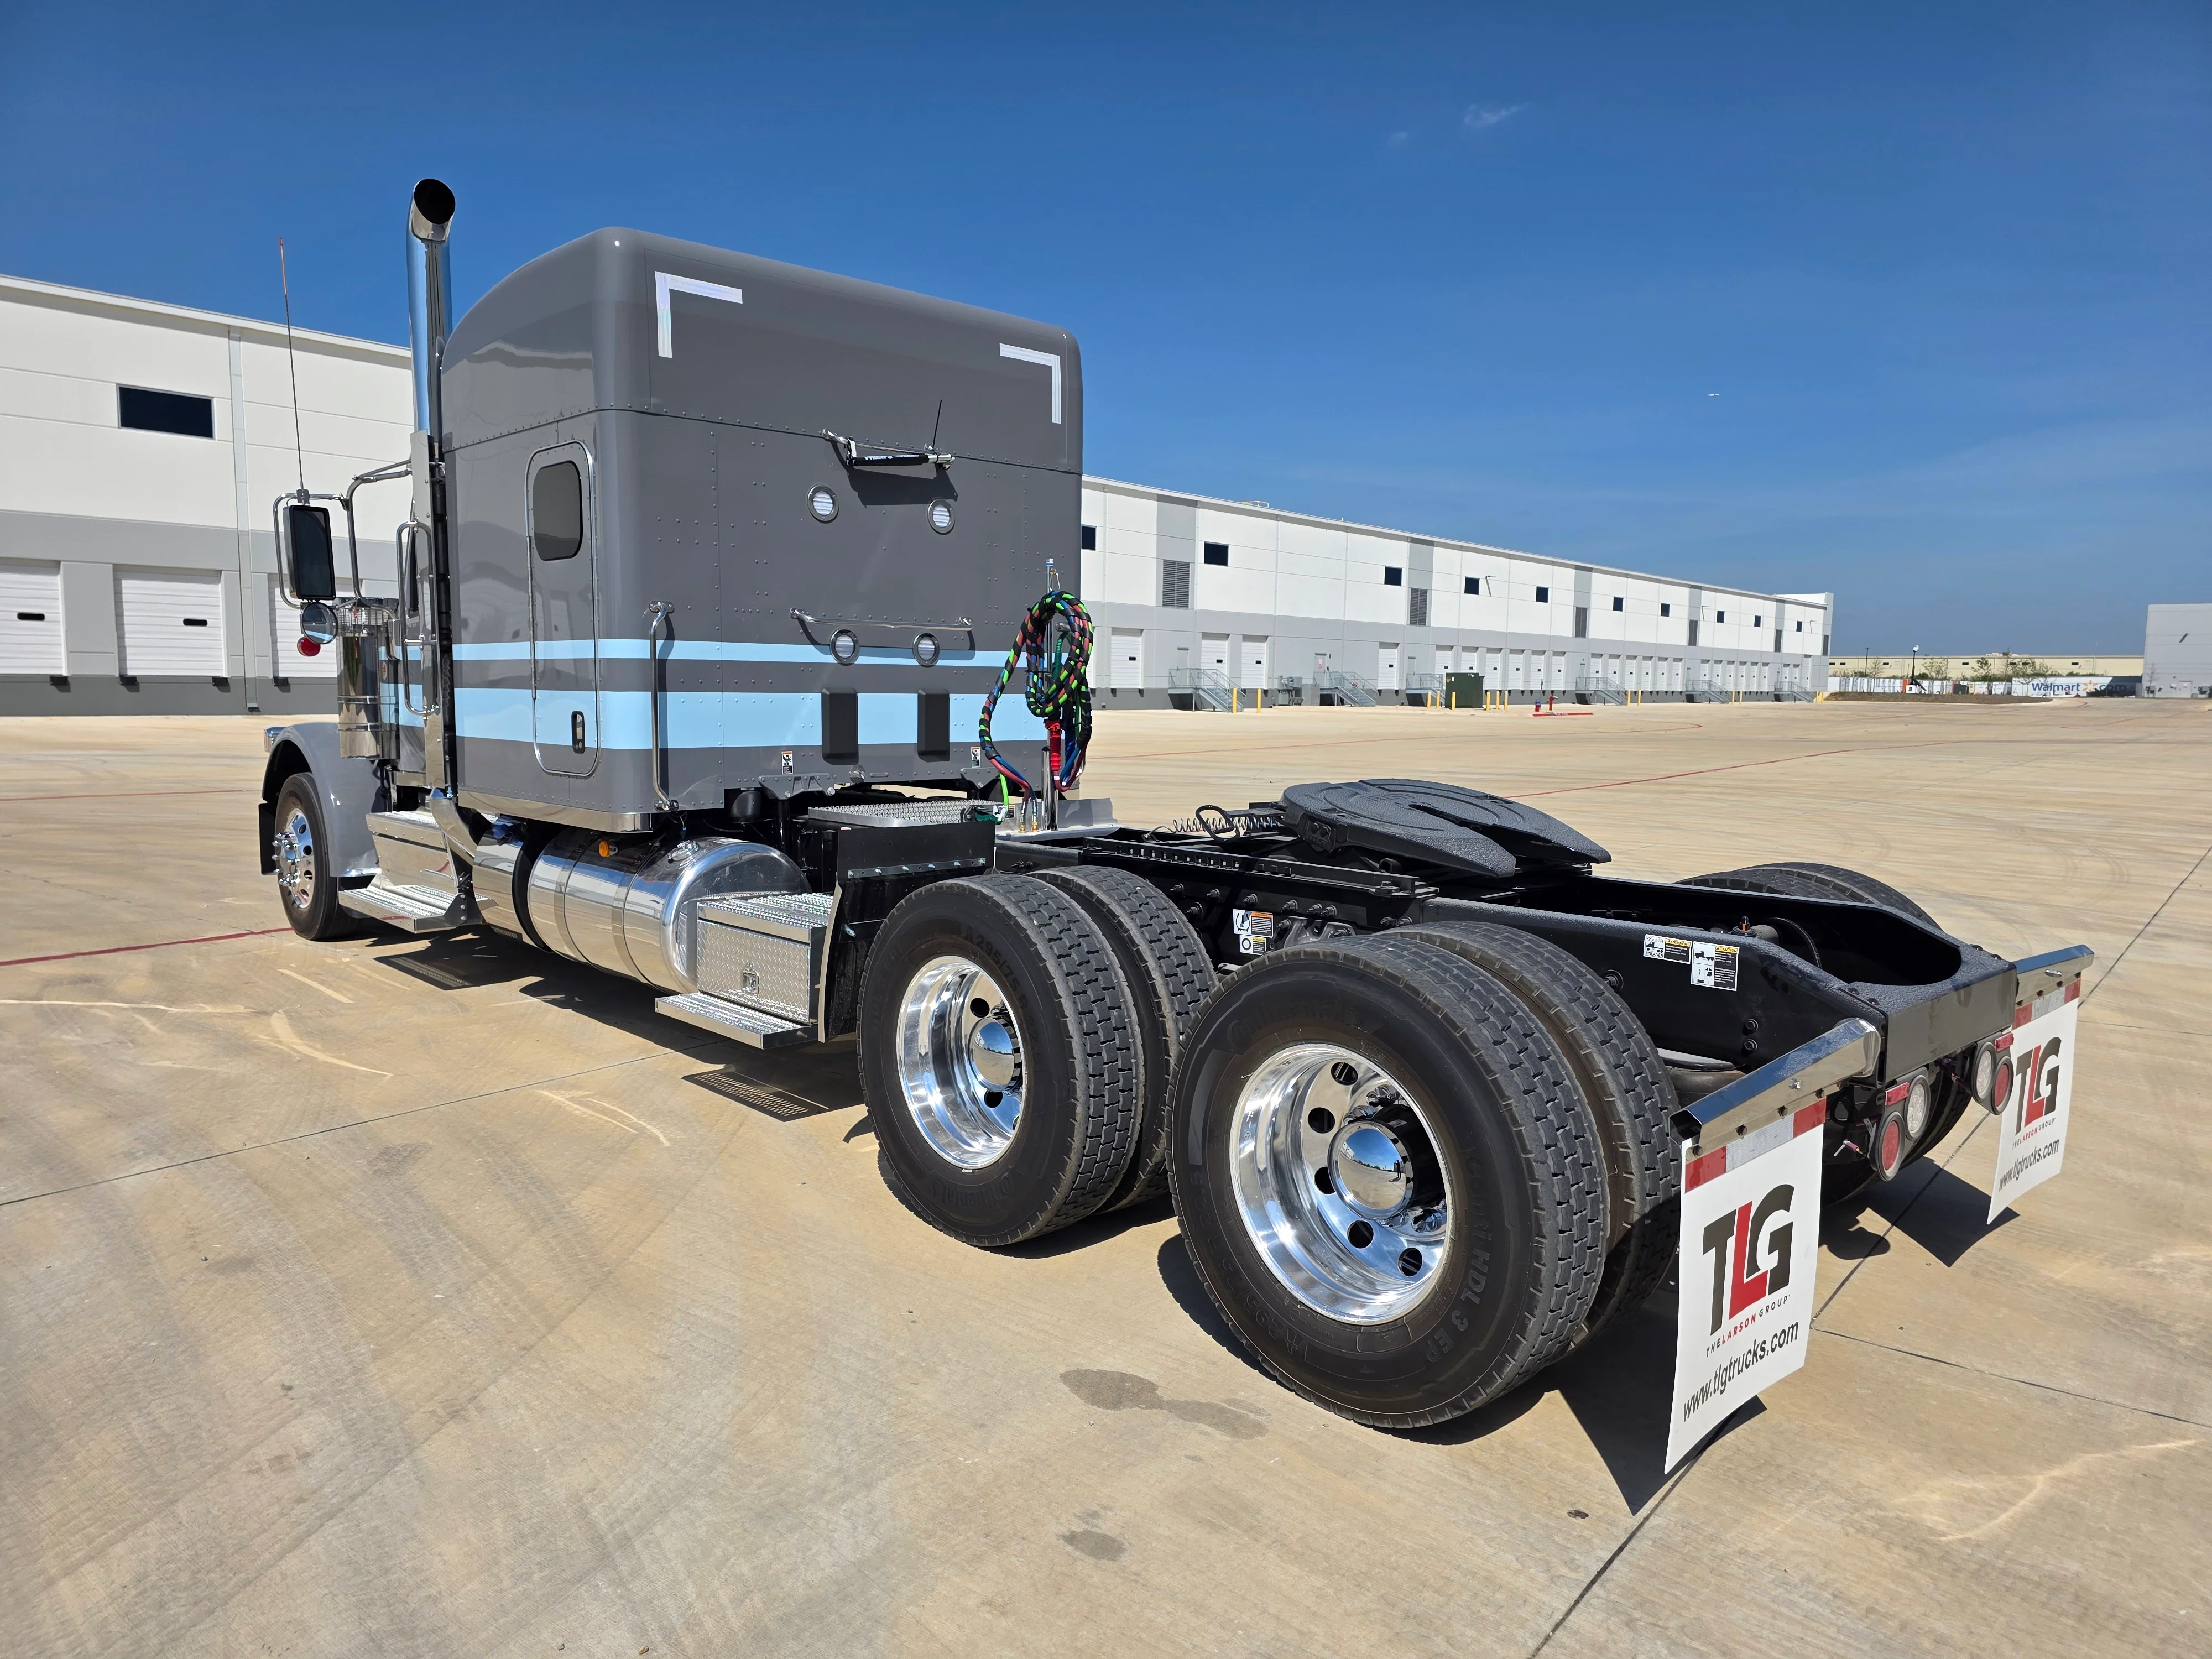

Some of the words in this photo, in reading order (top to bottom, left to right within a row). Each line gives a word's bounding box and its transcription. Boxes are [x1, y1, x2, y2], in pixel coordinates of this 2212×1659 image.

[2032, 682, 2080, 691] Walmart
[2015, 1036, 2062, 1136] TLG
[2038, 1118, 2054, 1131] GROUP
[1999, 1139, 2059, 1192] www.tlgtrucks.com
[1460, 1247, 1491, 1305] HDL
[1702, 1183, 1794, 1336] TLG
[1451, 1309, 1469, 1332] 3
[1759, 1295, 1788, 1317] GROUP
[1426, 1328, 1455, 1363] EP
[1683, 1322, 1799, 1422] www.tlgtrucks.com
